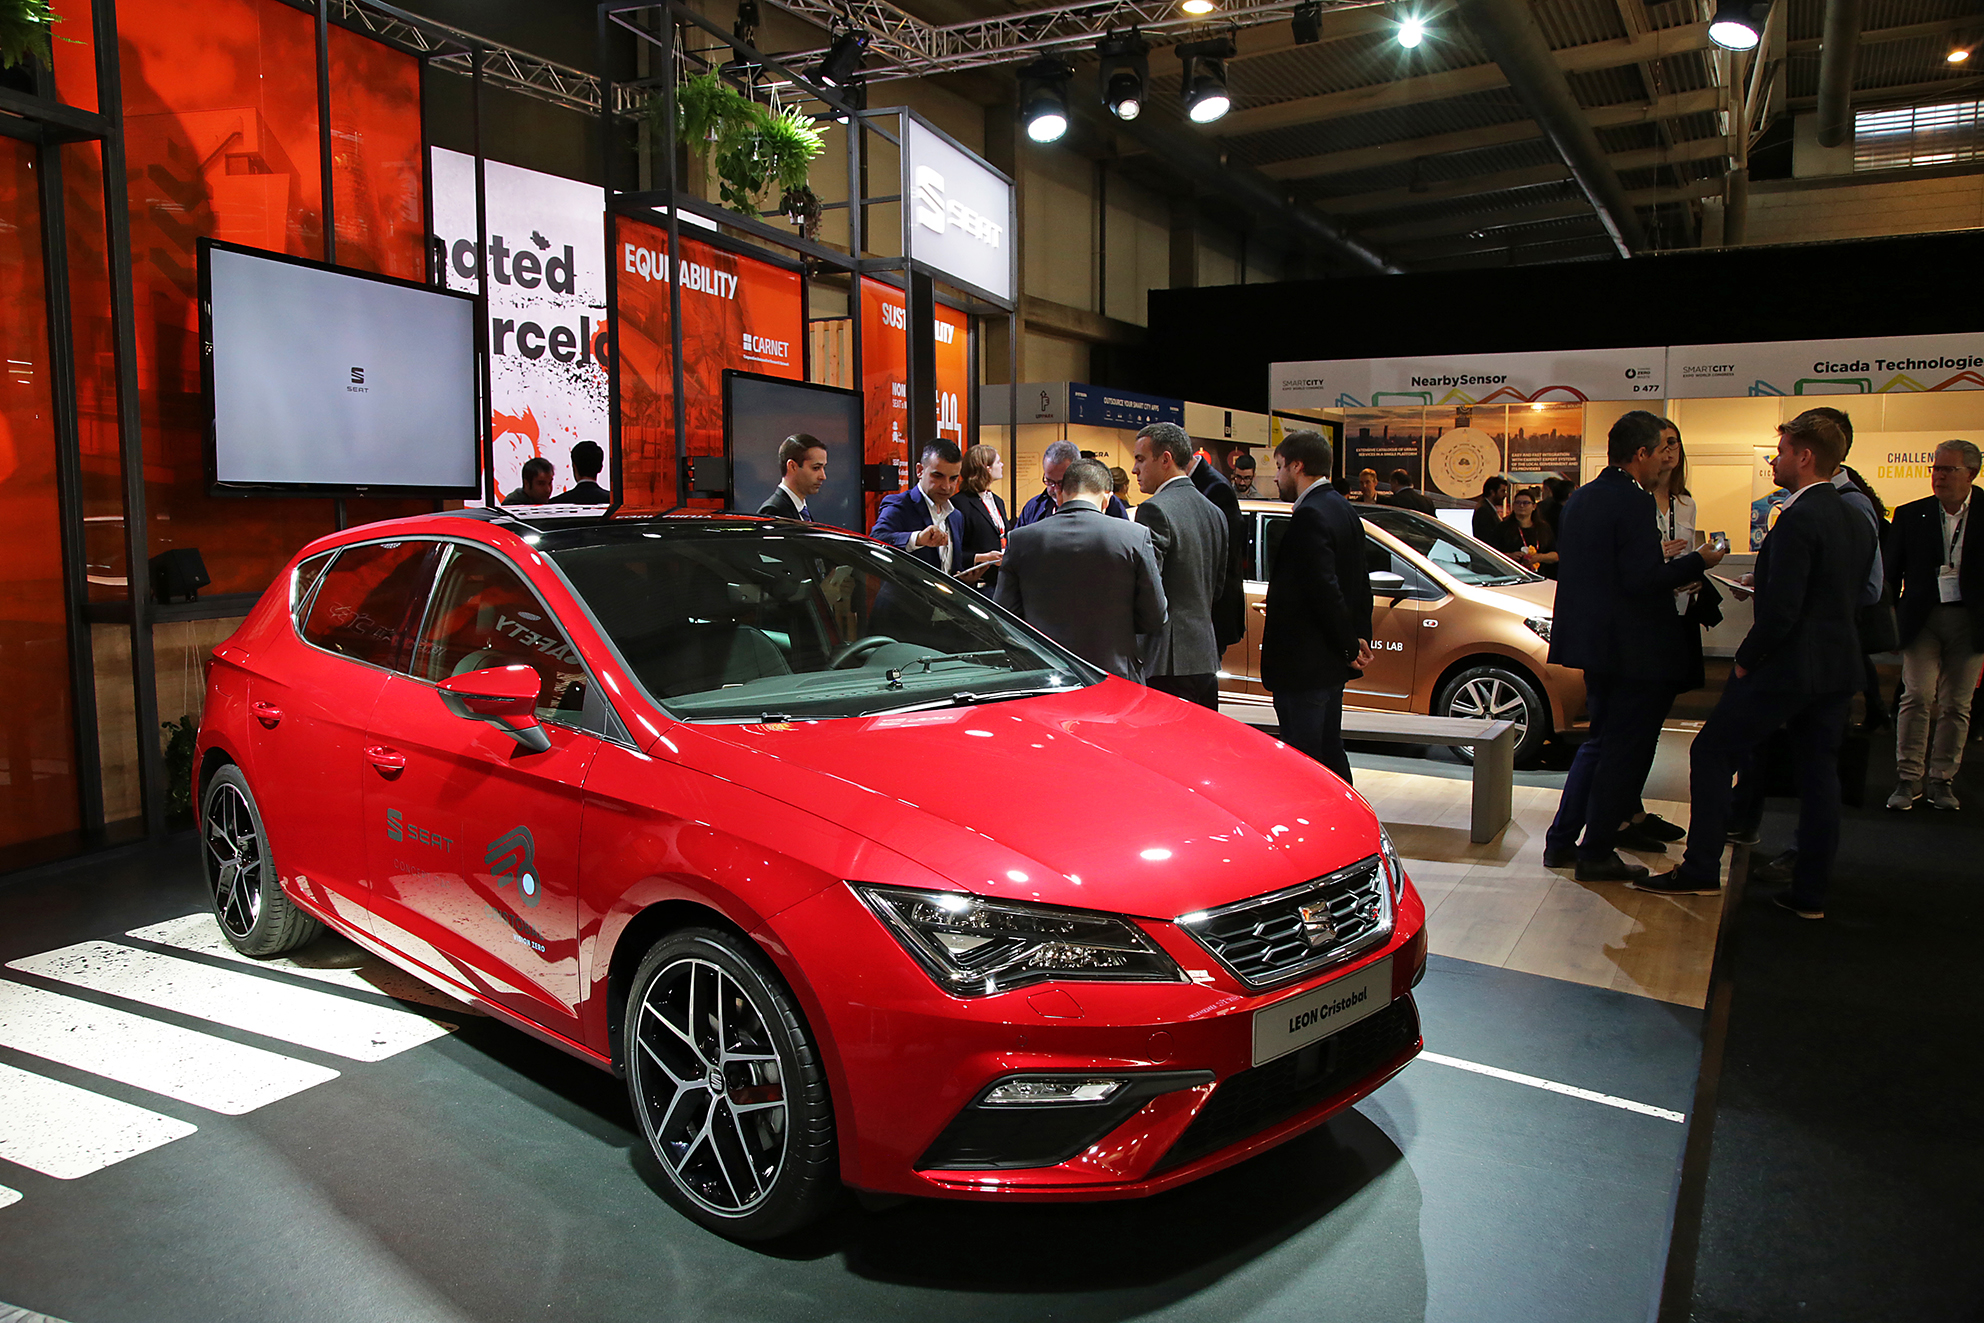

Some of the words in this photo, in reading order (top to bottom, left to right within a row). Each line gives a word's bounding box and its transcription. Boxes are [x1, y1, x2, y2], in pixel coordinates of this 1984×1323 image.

[946, 199, 1003, 248] SEAT
[625, 243, 738, 300] EQUIABILITY
[753, 336, 790, 357] CARNET
[1683, 365, 1735, 374] SMARTCITY
[1813, 360, 1870, 374] Cicada
[1282, 379, 1324, 387] SMARTCITY
[1411, 374, 1507, 388] NearbySensor
[1887, 452, 1934, 463] CHALLEN
[1386, 641, 1403, 652] LAB
[407, 824, 453, 853] SEAT
[484, 904, 545, 941] CRISTOBAL
[531, 941, 546, 953] ZERO
[1289, 1007, 1319, 1033] LEON
[1320, 986, 1368, 1020] Cristobal
